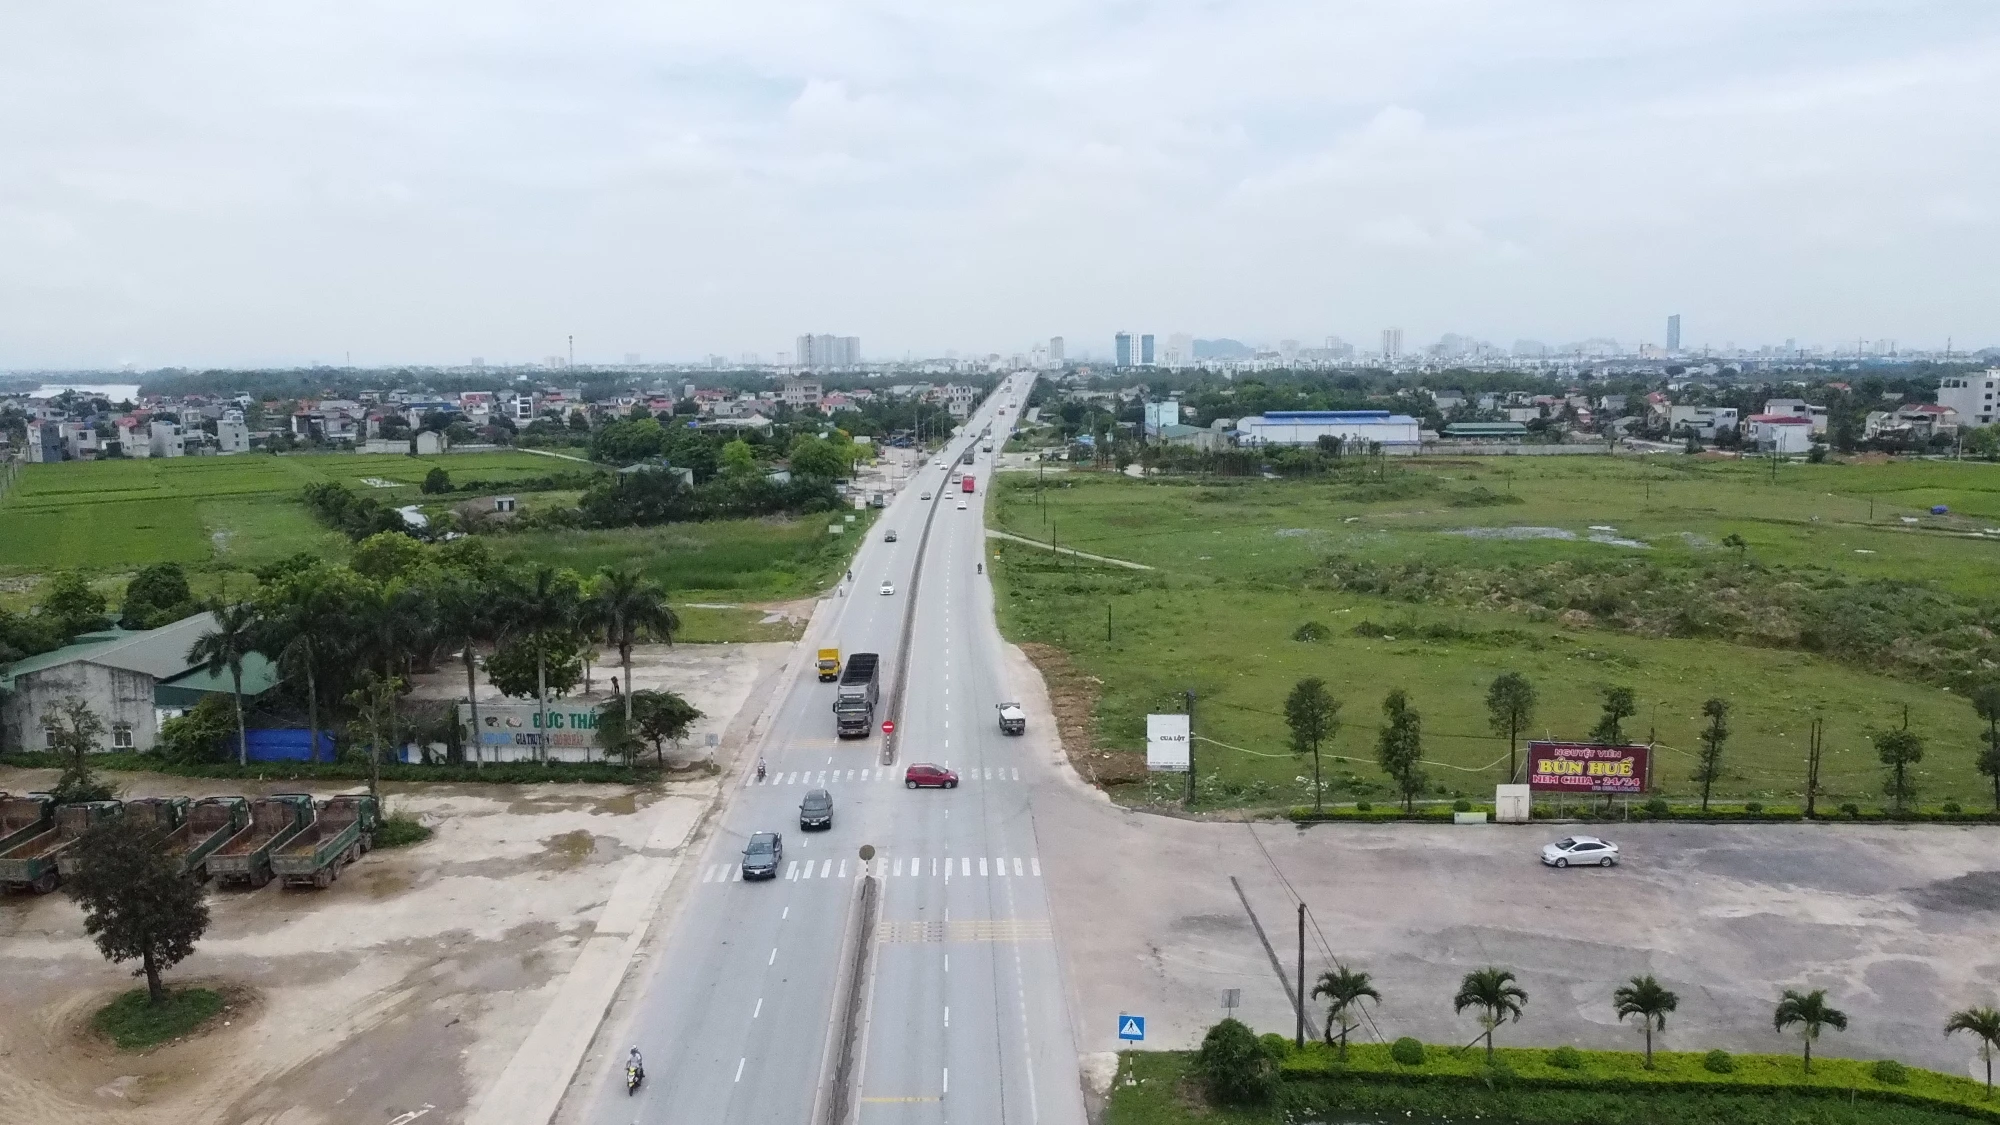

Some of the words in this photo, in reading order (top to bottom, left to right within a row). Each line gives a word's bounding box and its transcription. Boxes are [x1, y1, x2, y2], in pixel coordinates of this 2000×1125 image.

[568, 707, 604, 729] THẮ
[515, 733, 526, 745] GIA
[526, 733, 550, 745] TRUYN
[1554, 748, 1595, 759] NGUYỆT
[1597, 748, 1622, 759] VIÊN
[1537, 757, 1585, 775] BÚN
[1587, 757, 1634, 777] HUẾ
[1532, 774, 1559, 784] NEM
[1560, 775, 1594, 785] CHUA
[1603, 777, 1640, 787] 24/24
